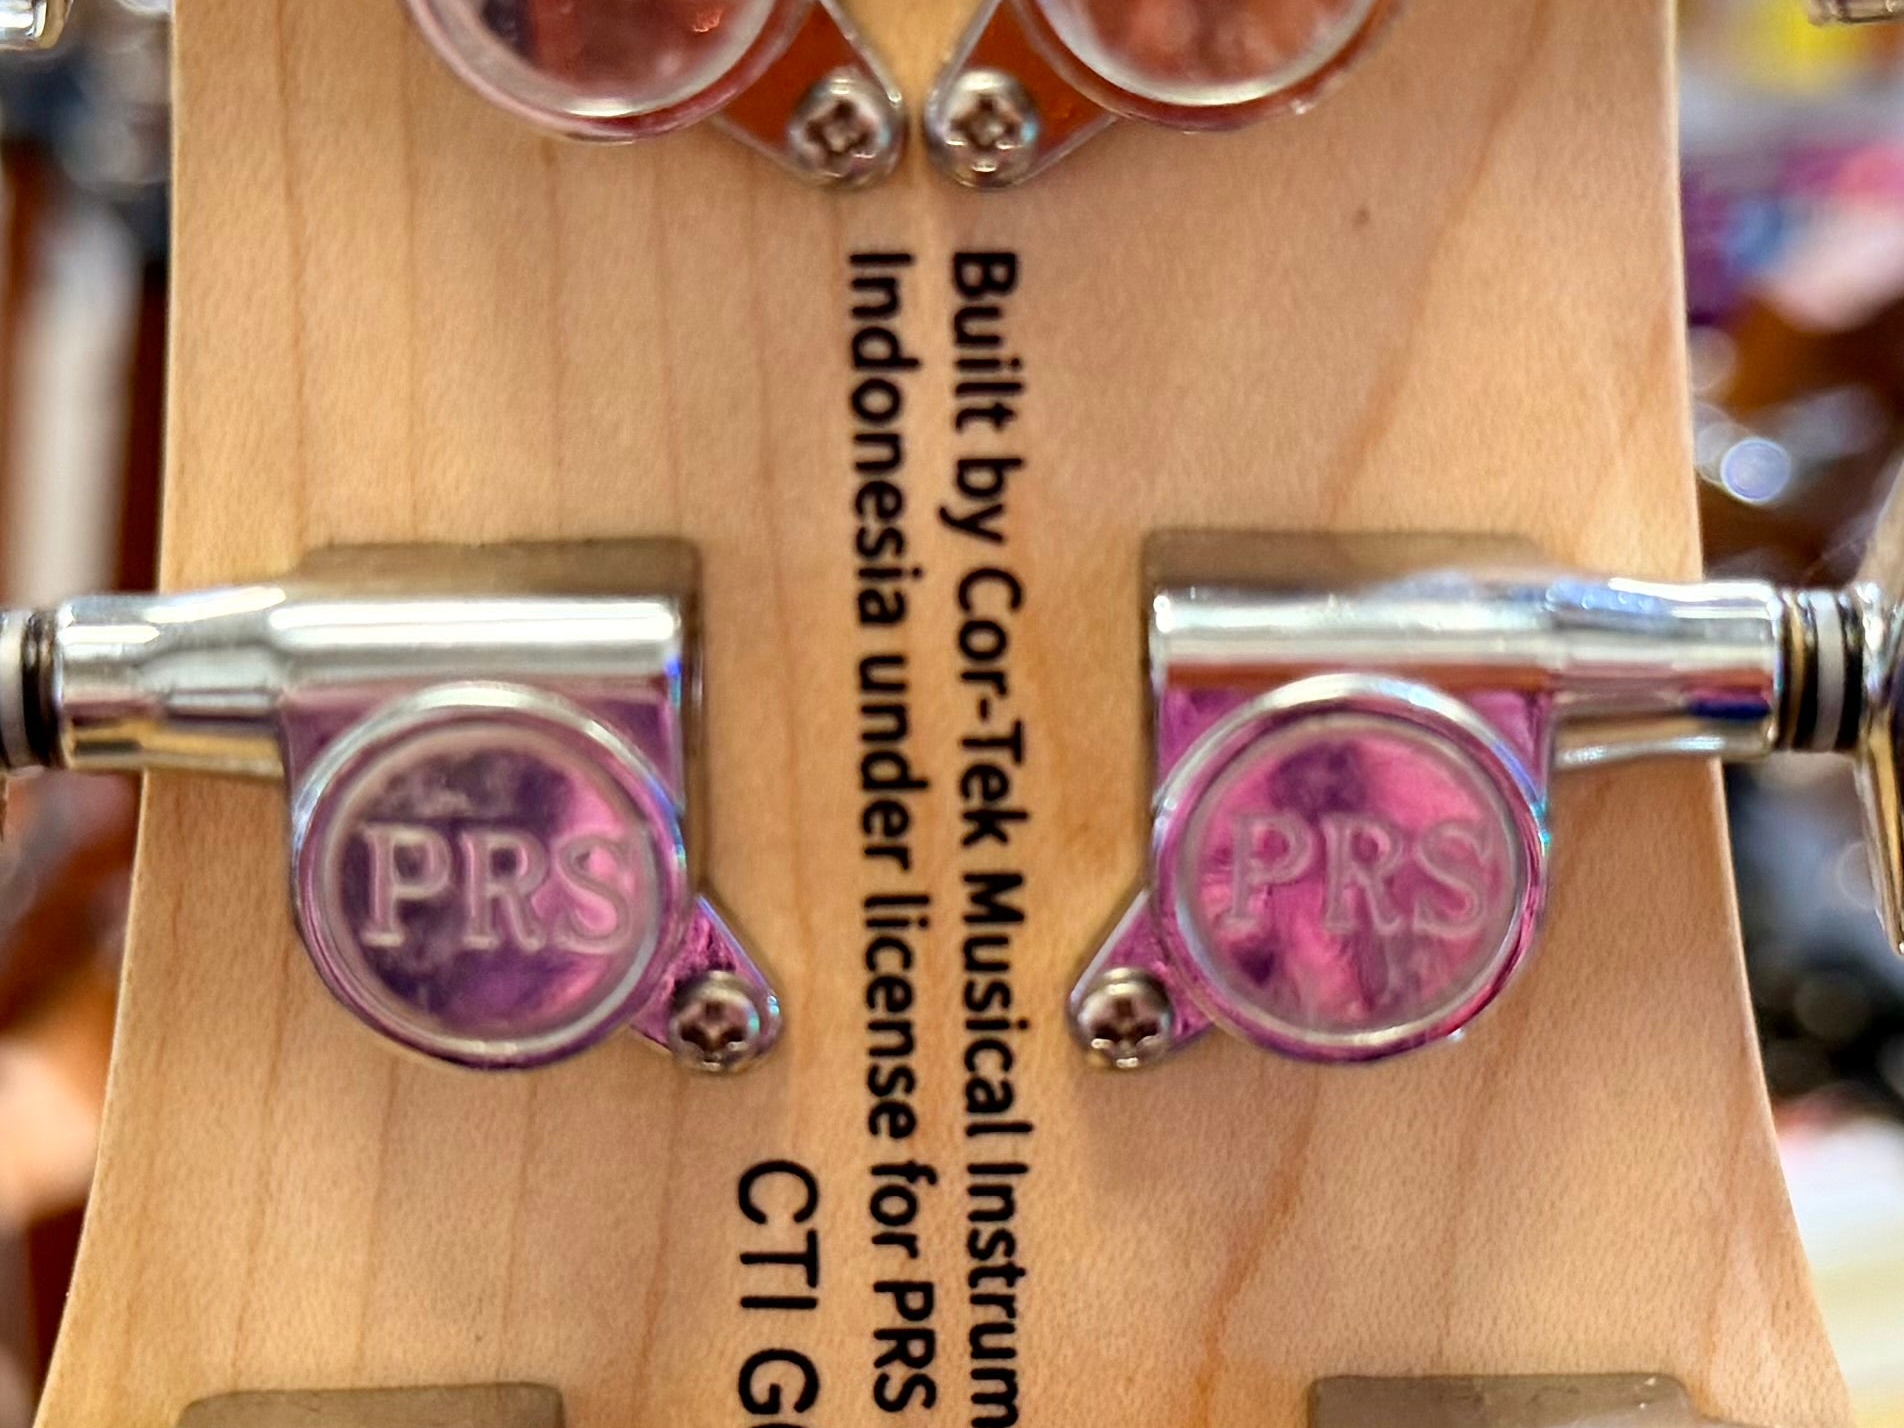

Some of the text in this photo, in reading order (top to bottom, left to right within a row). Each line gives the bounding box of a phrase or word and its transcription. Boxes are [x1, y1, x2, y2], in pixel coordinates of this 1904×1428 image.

[949, 248, 1026, 433] Built
[847, 250, 923, 629] Indonesia
[937, 455, 1026, 546] by
[856, 653, 931, 872] under
[955, 565, 1031, 849] Cor-Tek
[361, 820, 634, 956] PRS
[1221, 810, 1493, 940] PRS
[862, 892, 933, 1141] license
[959, 869, 1035, 1139] Musical
[736, 1158, 820, 1311] CTI
[868, 1159, 939, 1260] for
[872, 1279, 938, 1414] PRS
